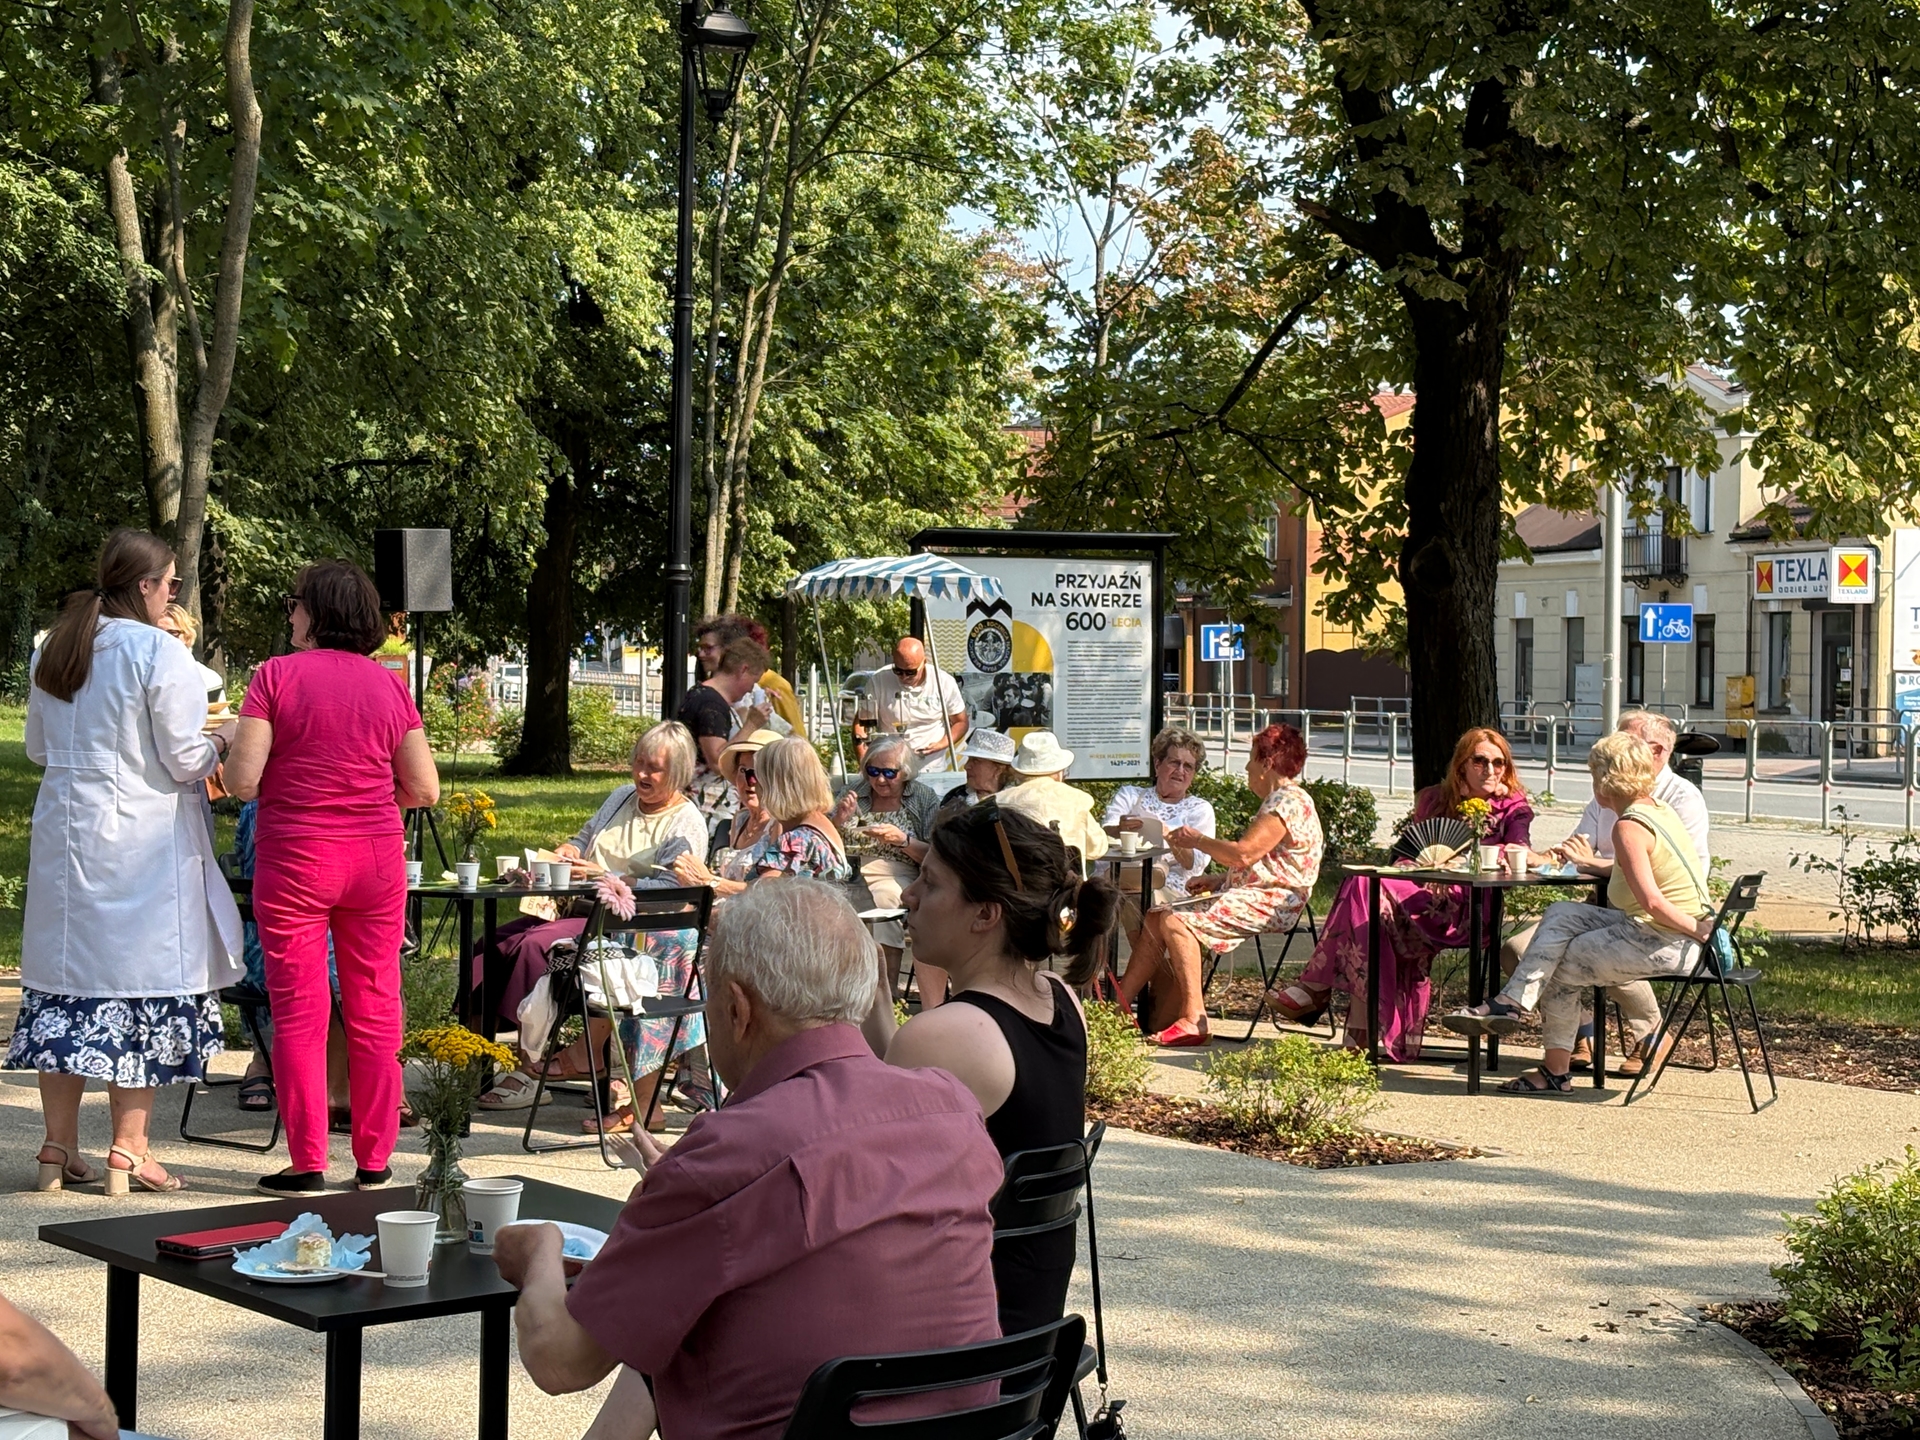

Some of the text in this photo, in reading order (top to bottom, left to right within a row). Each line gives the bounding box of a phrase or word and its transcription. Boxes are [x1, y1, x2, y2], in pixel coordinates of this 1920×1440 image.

[1055, 571, 1142, 590] PRZYJAŹŃ
[1778, 584, 1808, 593] ODZIEŻ
[1031, 592, 1142, 608] NA SKWERZE
[1065, 611, 1107, 631] 600
